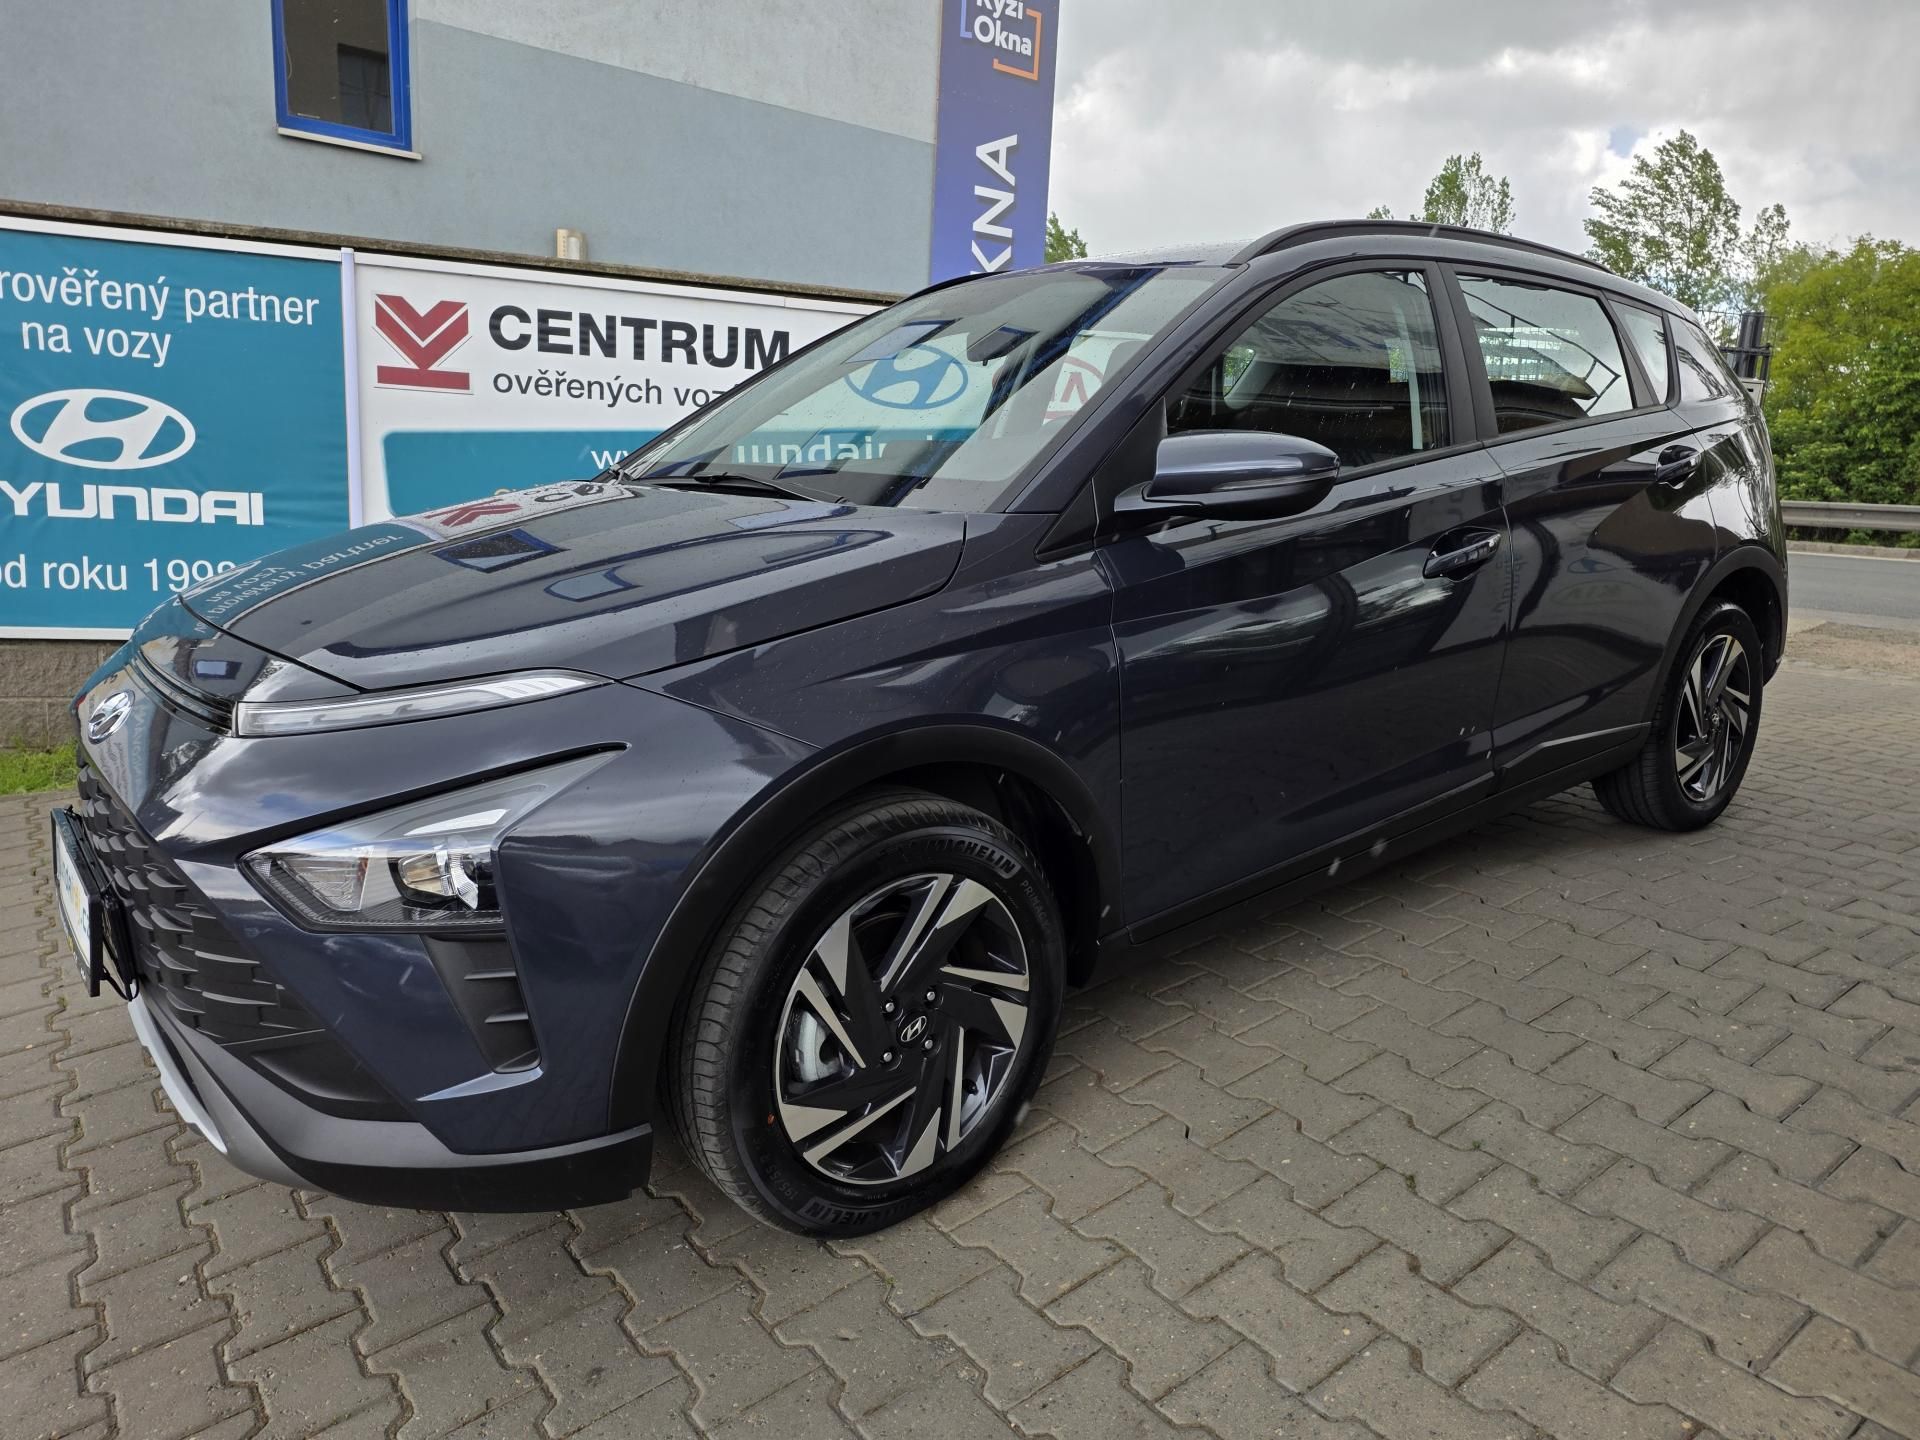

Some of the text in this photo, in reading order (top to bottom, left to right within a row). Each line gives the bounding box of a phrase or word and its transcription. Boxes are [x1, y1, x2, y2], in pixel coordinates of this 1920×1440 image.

[974, 15, 1032, 56] Okna
[185, 286, 319, 325] partner
[22, 321, 171, 368] na vozy
[488, 305, 790, 370] CENTRUM
[492, 368, 738, 408] ověřených vo
[0, 553, 27, 588] d
[43, 555, 128, 591] roku
